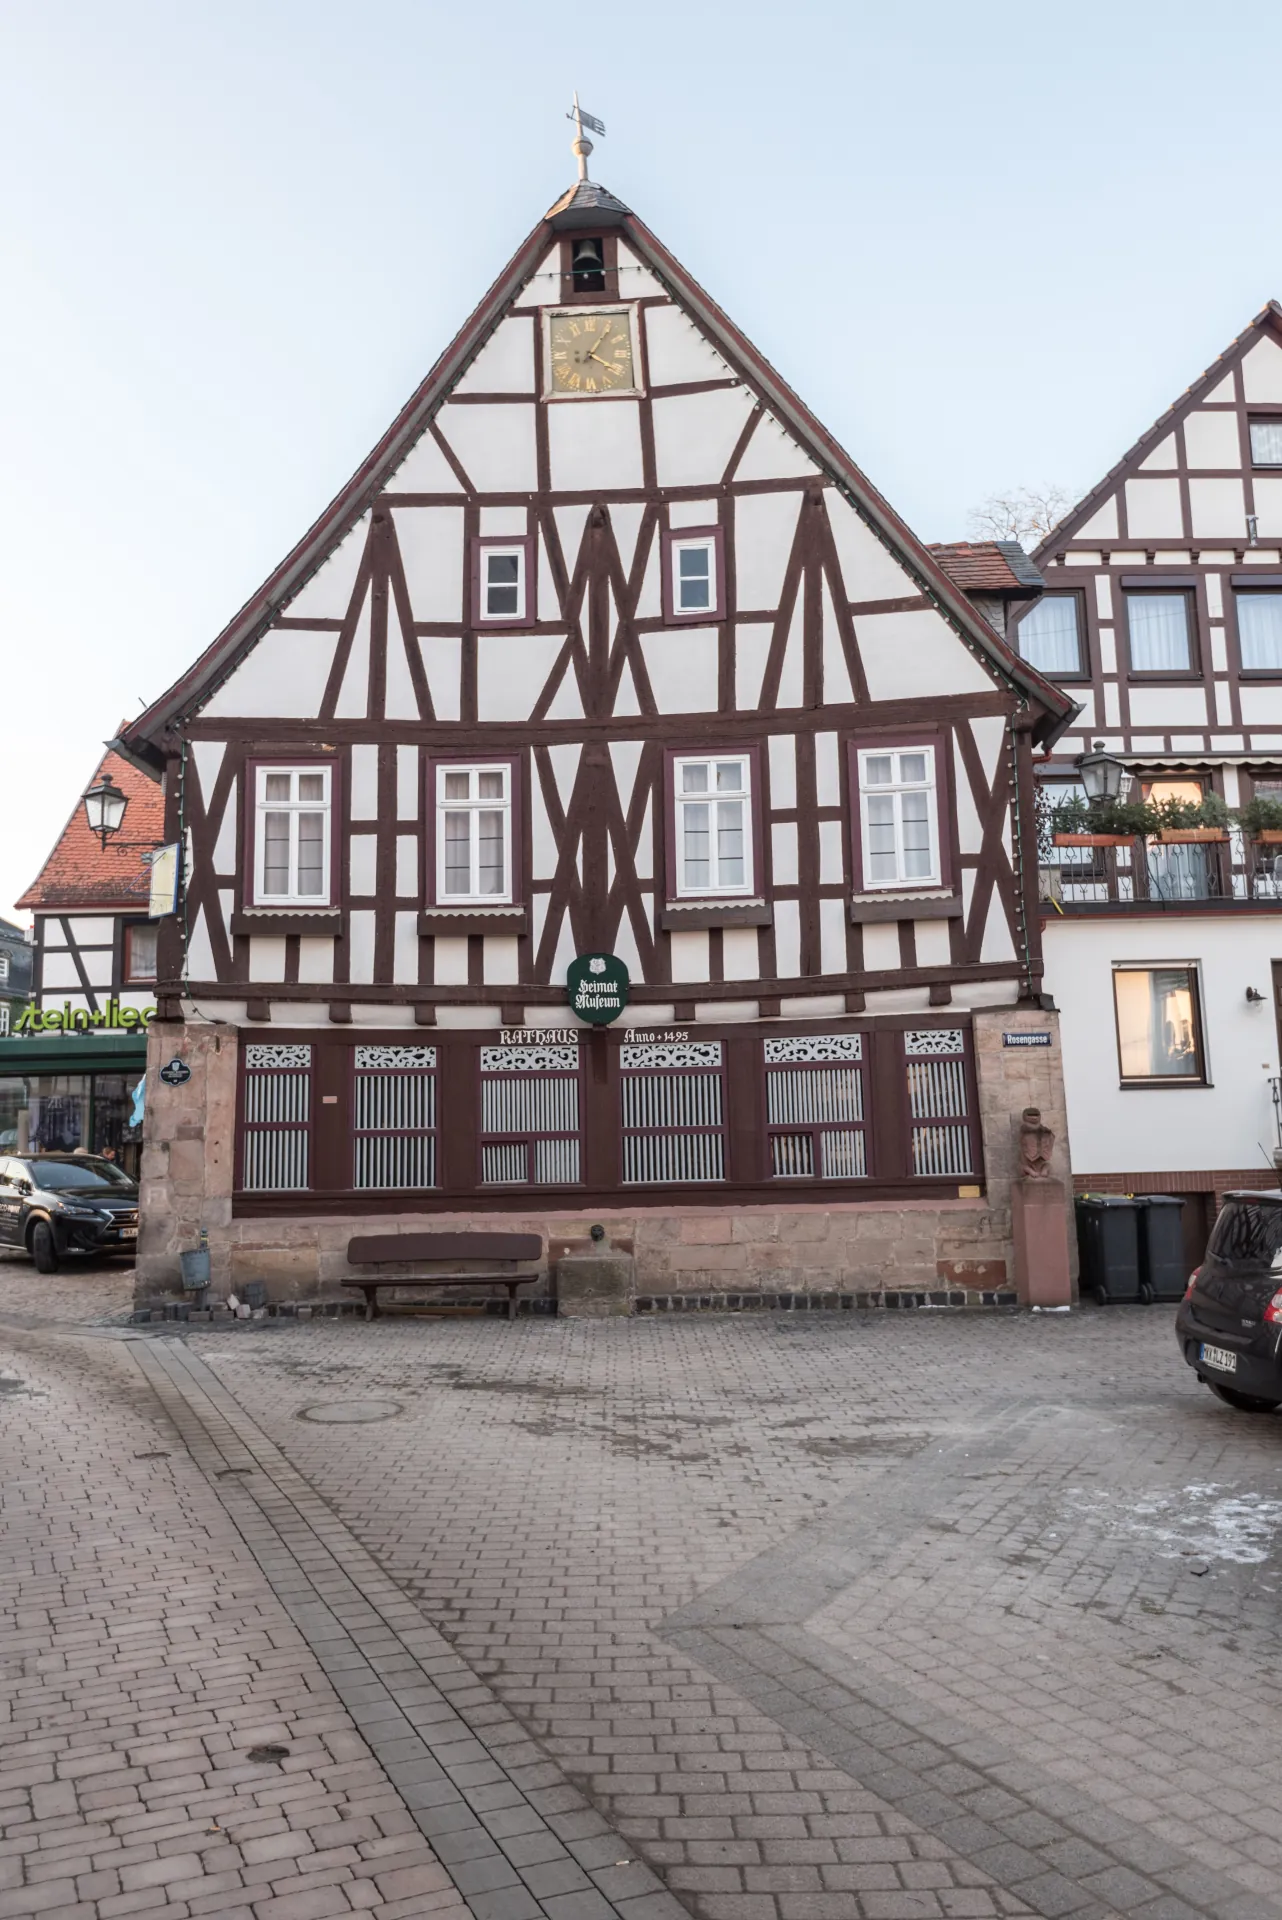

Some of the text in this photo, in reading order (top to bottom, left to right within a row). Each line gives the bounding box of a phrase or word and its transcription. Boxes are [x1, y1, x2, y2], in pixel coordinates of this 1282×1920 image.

[578, 979, 618, 995] Heimat
[500, 1029, 579, 1045] RATHAUS
[624, 1028, 655, 1043] Anno
[664, 1031, 689, 1042] 1495
[1007, 1034, 1048, 1046] Rosengasse
